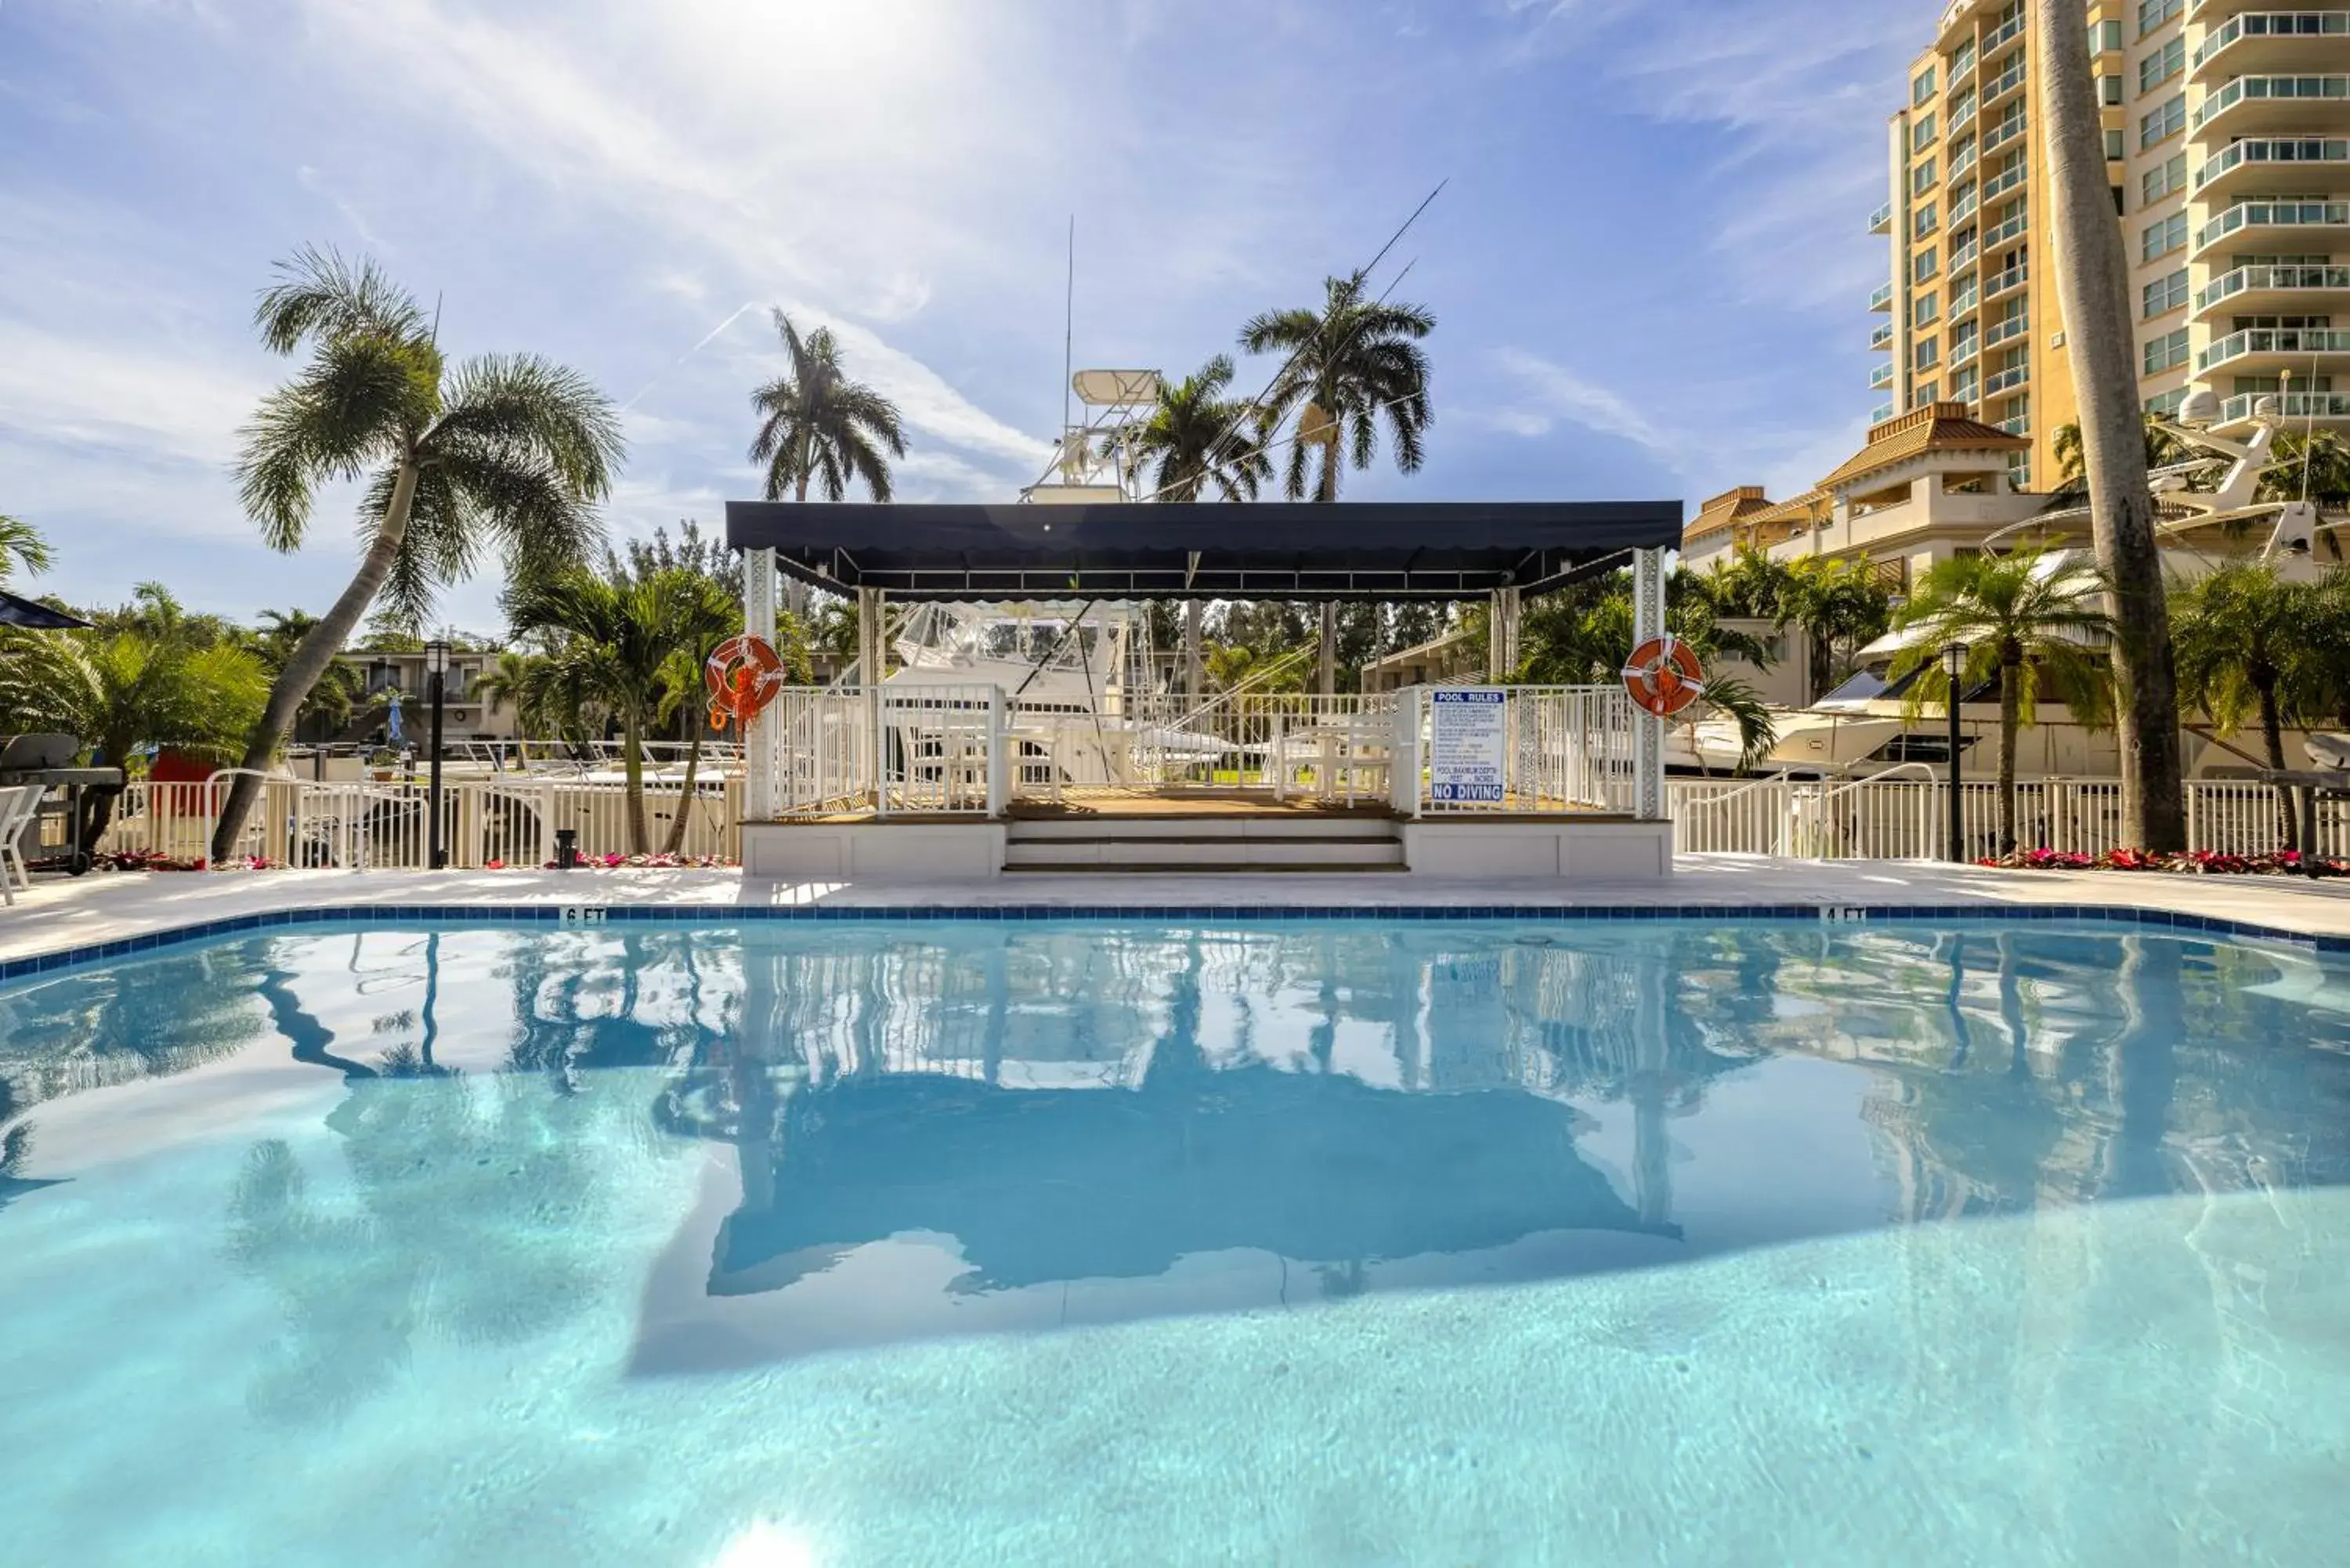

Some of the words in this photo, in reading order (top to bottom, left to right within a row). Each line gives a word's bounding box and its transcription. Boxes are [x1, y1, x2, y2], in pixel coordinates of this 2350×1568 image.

[1439, 693, 1463, 702] POOL
[1469, 693, 1499, 702] RULES
[1434, 785, 1452, 799] NO
[1458, 785, 1501, 800] DIVING
[584, 908, 605, 920] FT
